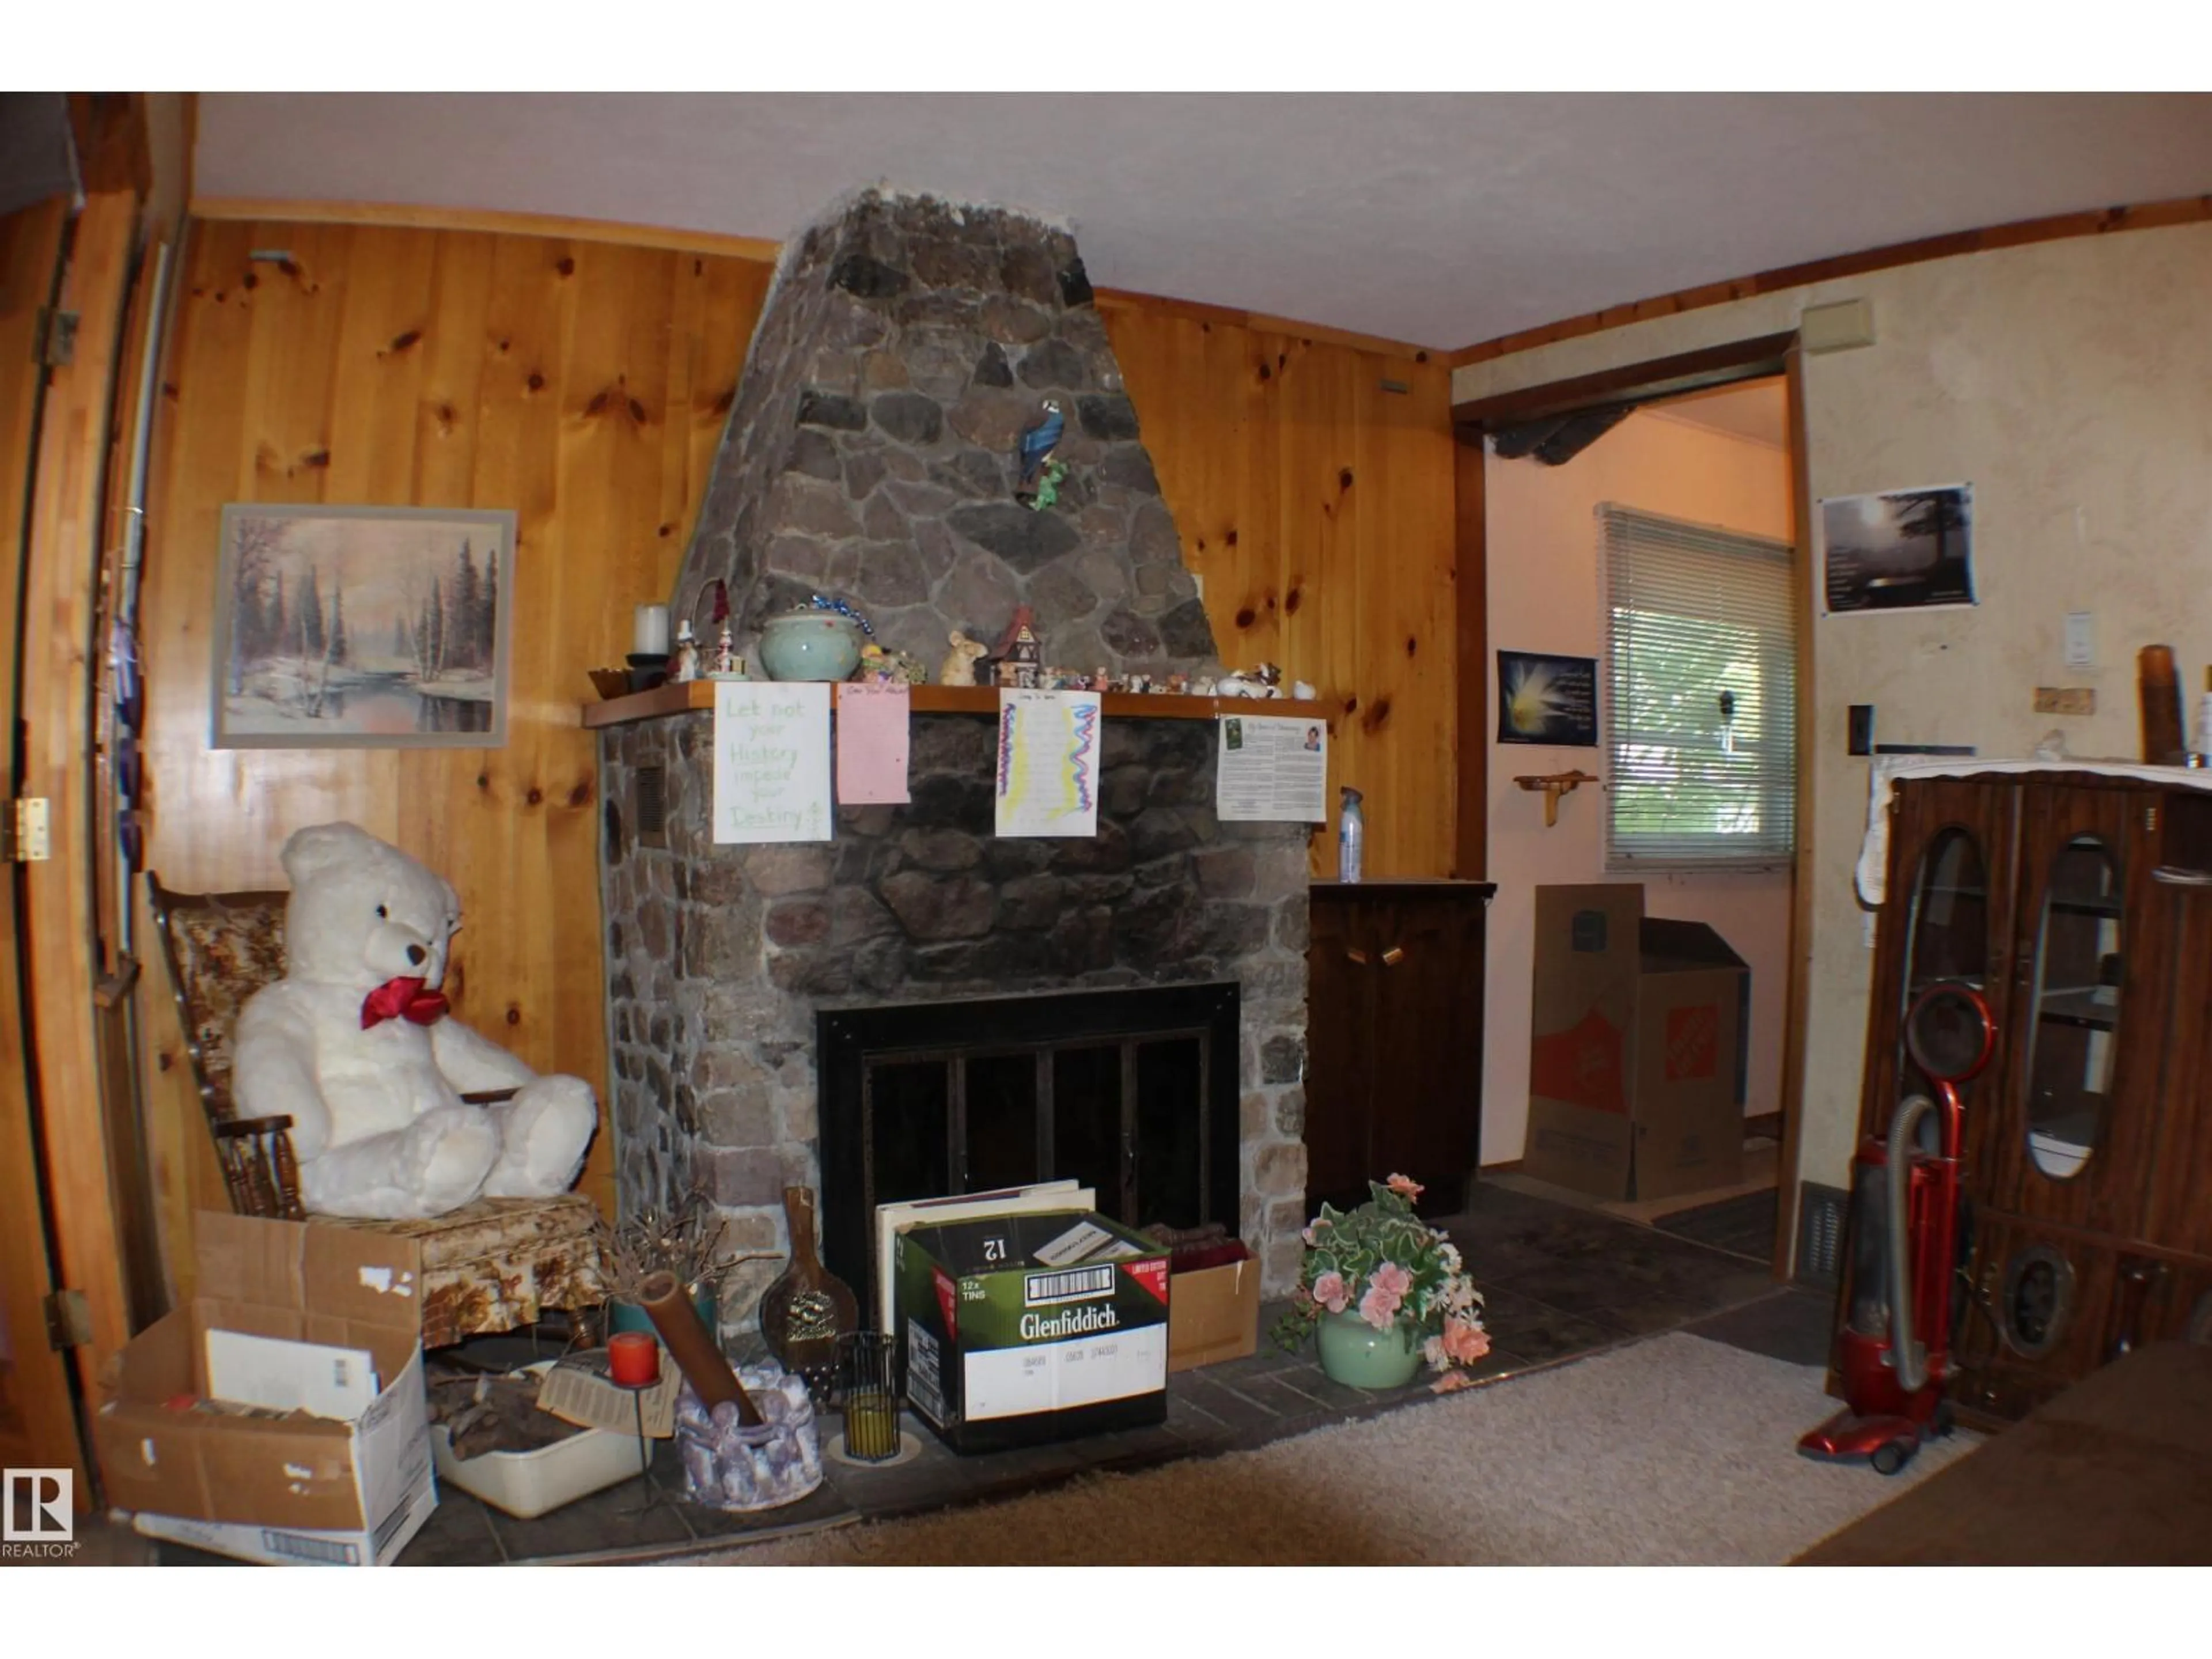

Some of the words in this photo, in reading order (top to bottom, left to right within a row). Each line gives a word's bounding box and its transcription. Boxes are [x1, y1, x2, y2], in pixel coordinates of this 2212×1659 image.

[726, 696, 761, 718] Let
[771, 697, 806, 718] not
[962, 1290, 986, 1302] TINS
[1020, 1302, 1116, 1340] Glenfiddich
